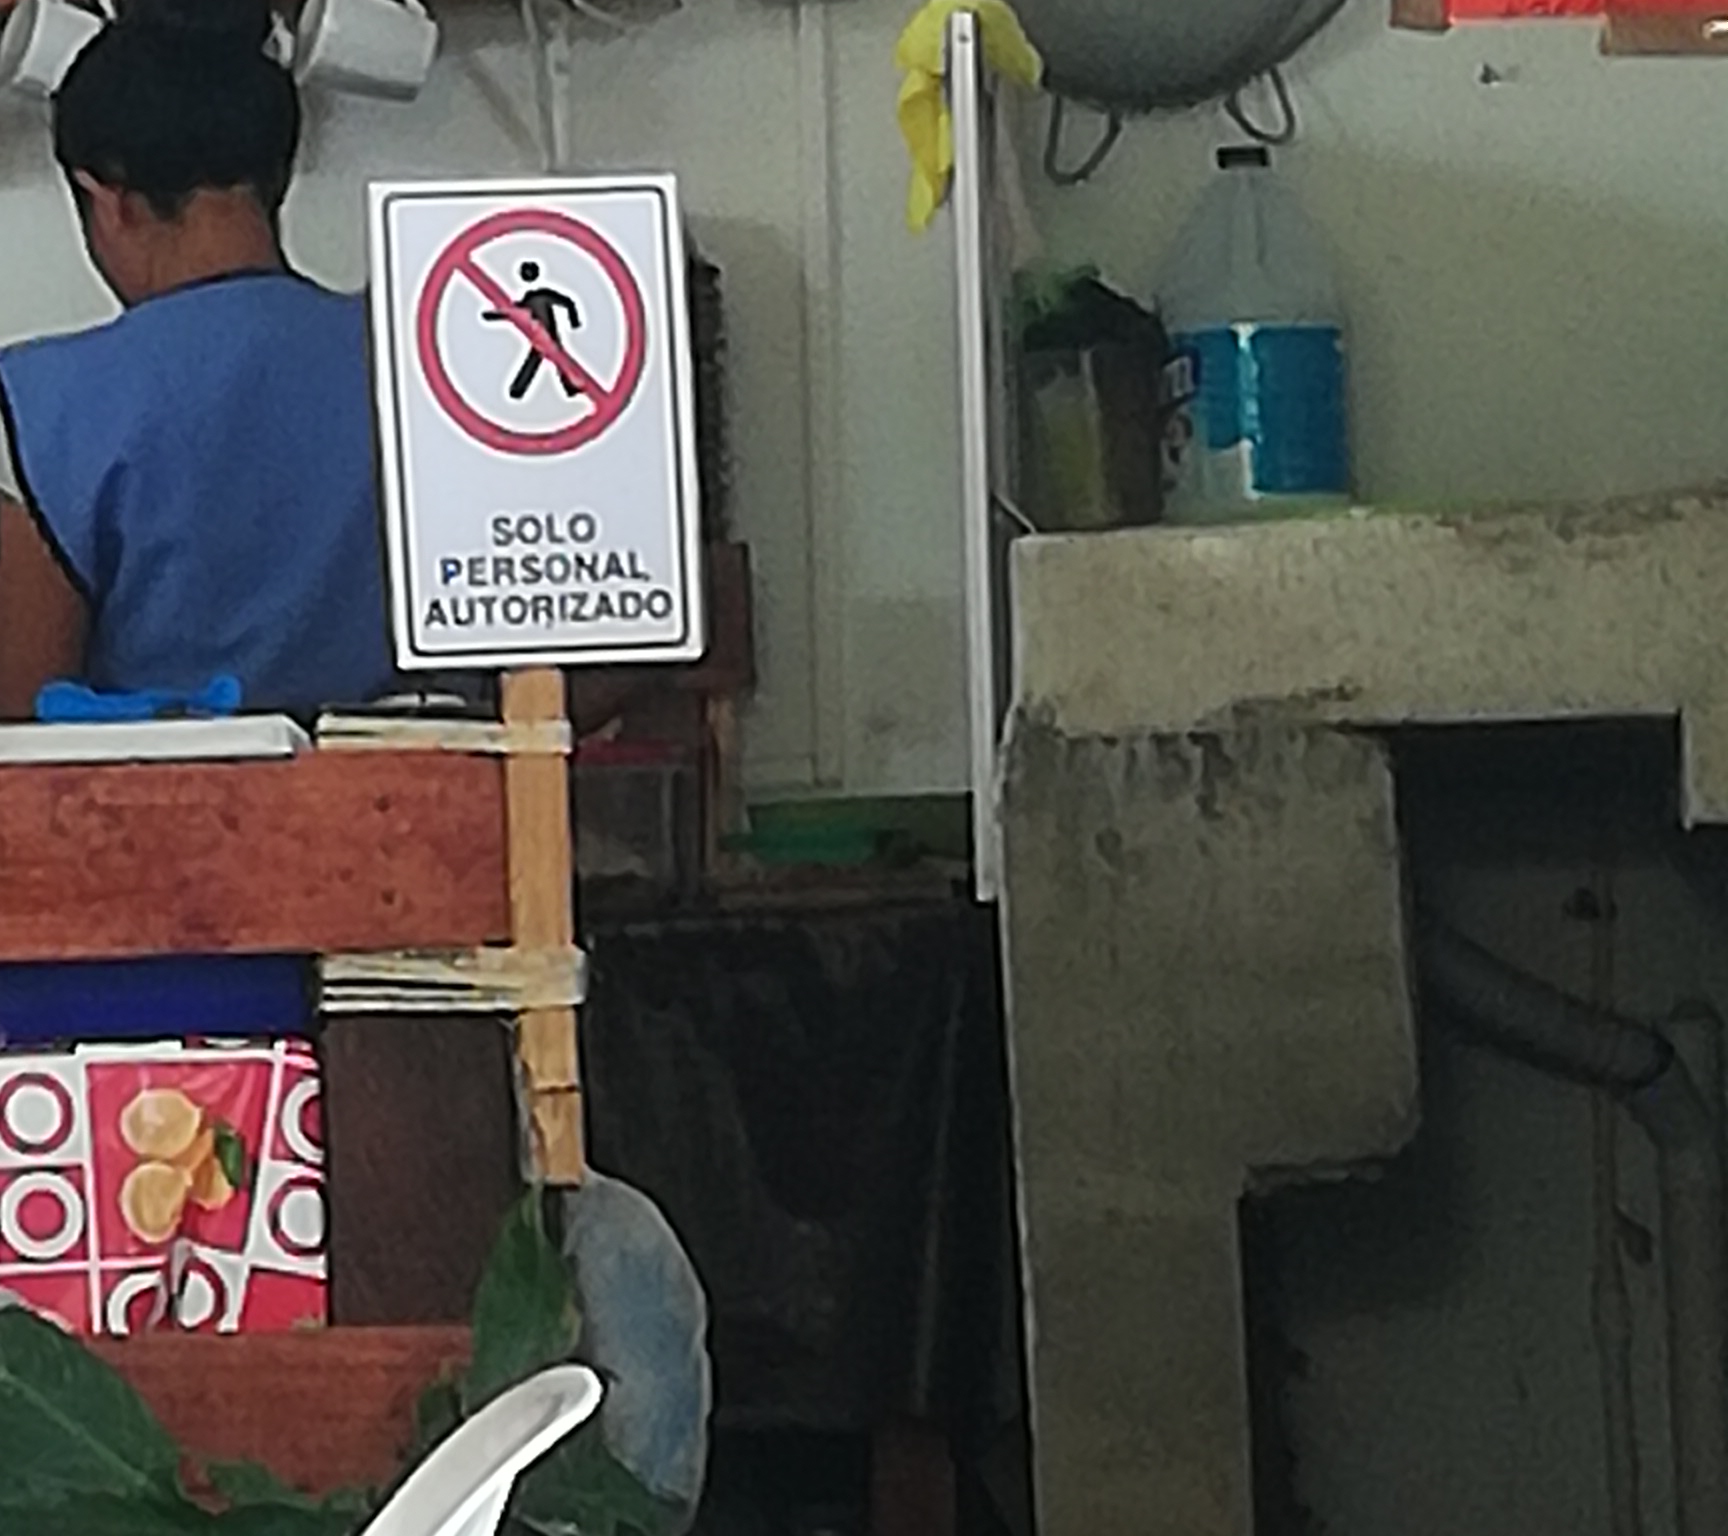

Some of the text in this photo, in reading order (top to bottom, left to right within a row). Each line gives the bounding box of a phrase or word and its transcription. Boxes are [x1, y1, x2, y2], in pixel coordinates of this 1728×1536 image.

[491, 511, 598, 548] SOLO
[440, 553, 650, 587] PERSONAL
[423, 589, 674, 629] AUTORIZADO
